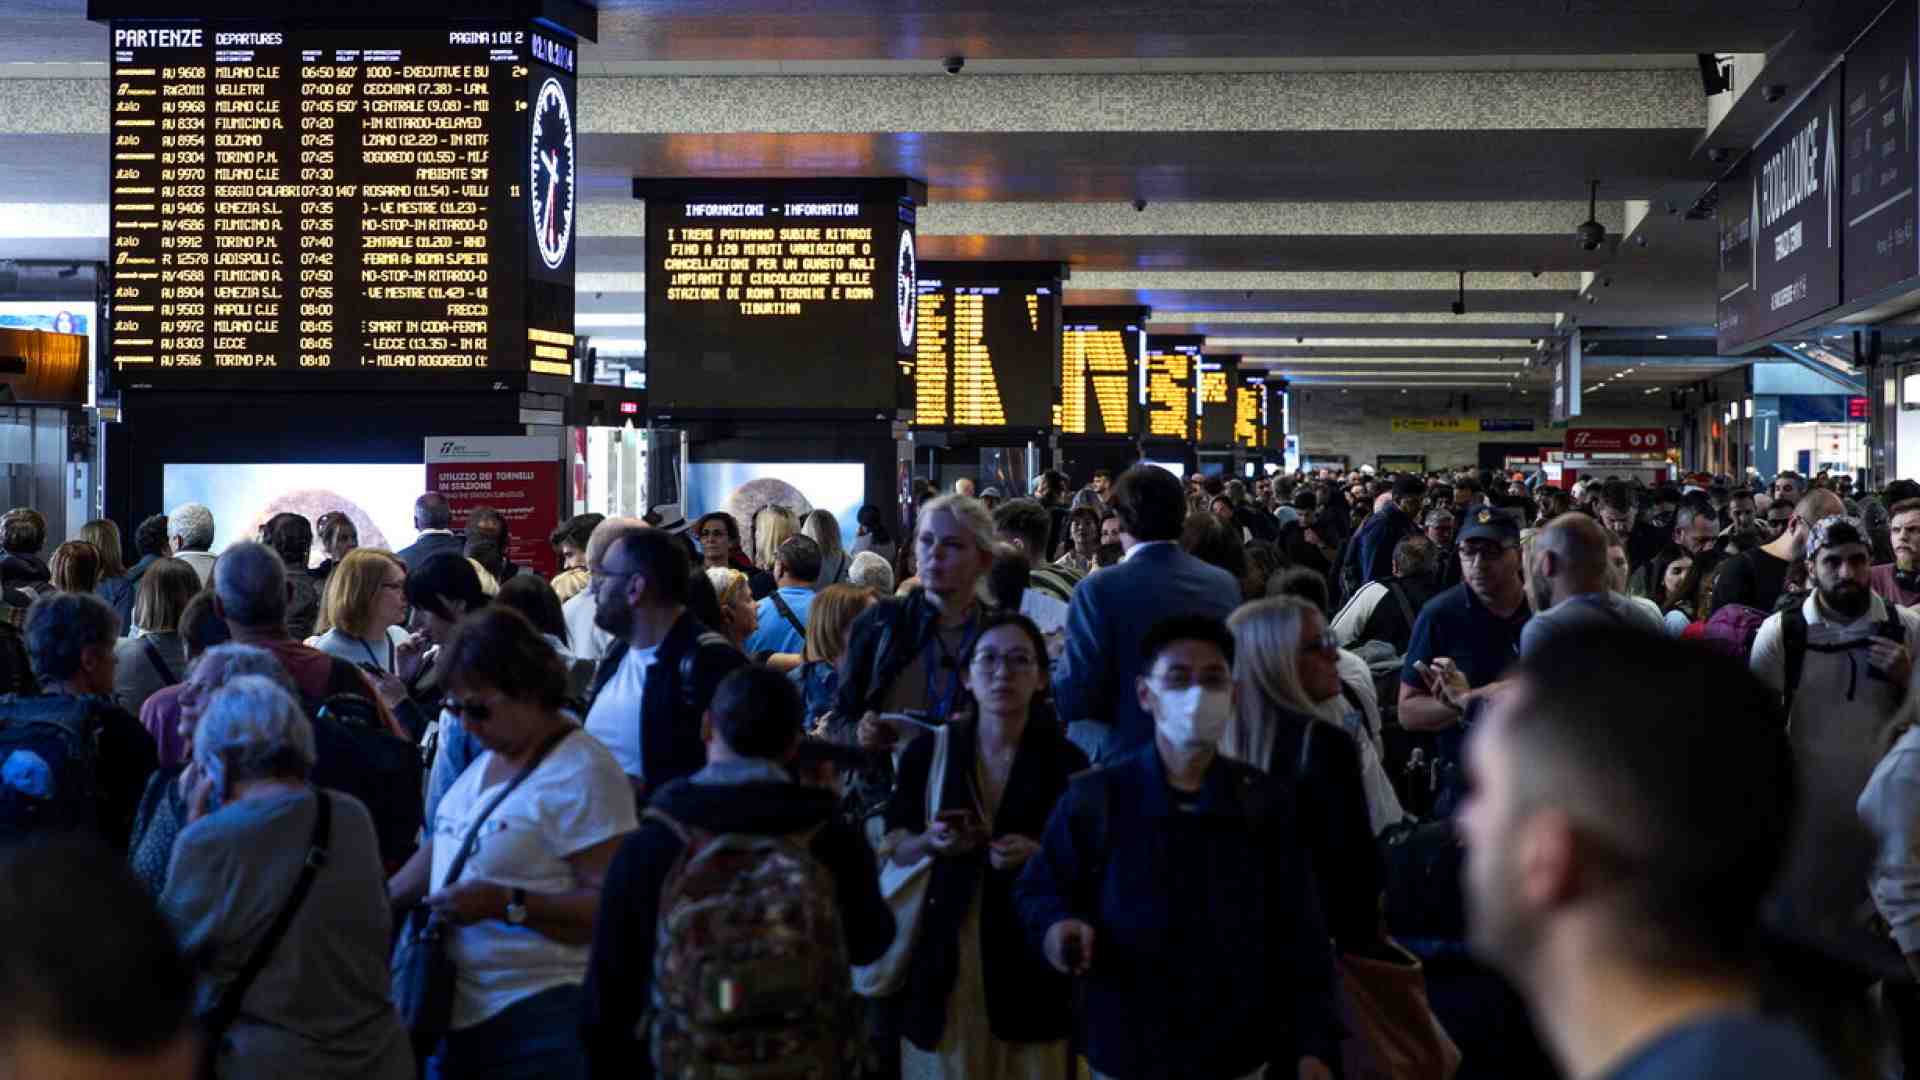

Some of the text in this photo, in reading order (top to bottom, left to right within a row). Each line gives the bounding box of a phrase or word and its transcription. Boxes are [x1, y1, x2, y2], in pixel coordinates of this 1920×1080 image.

[116, 29, 524, 48] PARTENZE DEPARTURES PAGINA 1 DI 2
[178, 66, 206, 78] 9608
[216, 66, 253, 78] MILANO
[256, 66, 280, 78] C.LE
[302, 66, 334, 78] 06:50
[367, 66, 391, 78] 1000
[403, 66, 462, 78] EXECUTIVE
[464, 66, 472, 78] E
[513, 66, 521, 78] 2
[215, 83, 264, 95] VELLETRI
[302, 83, 335, 95] 07:00
[363, 83, 415, 95] CECCHINA
[418, 83, 452, 95] (7.38)
[178, 100, 206, 112] 9968
[216, 100, 253, 112] MILANO
[256, 100, 280, 112] C.LE
[302, 100, 335, 112] 07:05
[372, 100, 425, 112] CENTRALE
[428, 100, 462, 112] (9.08)
[178, 117, 205, 129] 8334
[215, 117, 270, 129] FIUMICINO
[302, 117, 333, 129] 07:20
[385, 117, 482, 129] RITARDO-DELAYED
[178, 134, 205, 146] 8954
[216, 134, 262, 146] BOLZANO
[302, 134, 334, 146] 07:25
[400, 134, 438, 146] (12.22)
[178, 151, 205, 163] 9304
[216, 151, 254, 163] TORINO
[302, 151, 334, 163] 07:25
[417, 151, 456, 163] (10.55)
[178, 168, 469, 180] 9970 MILANO C.LE 07:30 AMBIENTE
[178, 185, 205, 197] 8333
[215, 185, 254, 197] REGGIO
[256, 185, 300, 197] CALABRI
[301, 185, 333, 197] 07:30
[363, 185, 412, 197] ROSARNO
[414, 185, 450, 197] (11.54)
[511, 185, 520, 197] 11
[178, 202, 205, 214] 9406
[215, 202, 260, 214] VENEZIA
[301, 202, 334, 214] 07:35
[397, 202, 438, 214] MESTRE
[440, 202, 477, 214] (11.23)
[686, 204, 859, 216] INFORMAZIONI INFORMATION
[178, 219, 205, 231] 4586
[215, 219, 270, 231] FIUMICINO
[301, 219, 334, 231] 07:35
[681, 228, 714, 240] TRENI
[720, 228, 775, 240] POTRANNO
[780, 228, 821, 240] SUBIRE
[826, 228, 873, 240] RITARDI
[177, 236, 203, 248] 9912
[216, 236, 254, 248] TORINO
[301, 236, 334, 248] 07:40
[671, 243, 699, 255] FINO
[704, 243, 712, 255] A
[744, 243, 783, 255] MINUTI
[790, 243, 855, 255] VARIAZIONI
[177, 253, 209, 265] 12578
[214, 253, 270, 265] LADISPOLI
[272, 253, 283, 265] C.
[301, 253, 334, 265] 07:42
[416, 253, 445, 265] ROMA
[665, 258, 875, 270] CANCELLAZIONI PER UN GUASTO AGLI
[177, 270, 205, 282] 4588
[214, 270, 270, 282] FIUMICINO
[301, 270, 334, 282] 07:50
[671, 273, 871, 285] IMPIANTI DI CIRCOLAZIONE NELLE
[177, 287, 204, 299] 8904
[214, 287, 260, 299] VENEZIA
[301, 287, 334, 299] 07:55
[385, 287, 426, 299] MESTRE
[667, 288, 874, 300] STAZIONI DI ROMA TERMINI E ROMA
[177, 304, 334, 316] 9503 NAPOLI C.LE 08:00
[740, 303, 801, 315] TIBURTINA
[177, 321, 204, 333] 9972
[214, 321, 253, 333] MILANO
[255, 321, 279, 333] C.LE
[300, 321, 333, 333] 08:05
[368, 321, 403, 333] SMART
[421, 321, 487, 333] CODA-FERMA
[176, 338, 204, 350] 8303
[214, 338, 247, 350] LECCE
[300, 338, 333, 350] 08:05
[373, 338, 407, 350] LECCE
[409, 338, 448, 350] (13.35)
[176, 354, 202, 366] 9516
[215, 354, 254, 366] TORINO
[300, 354, 331, 366] 08:10
[377, 354, 416, 366] MILANO
[418, 354, 473, 366] ROGOREDO
